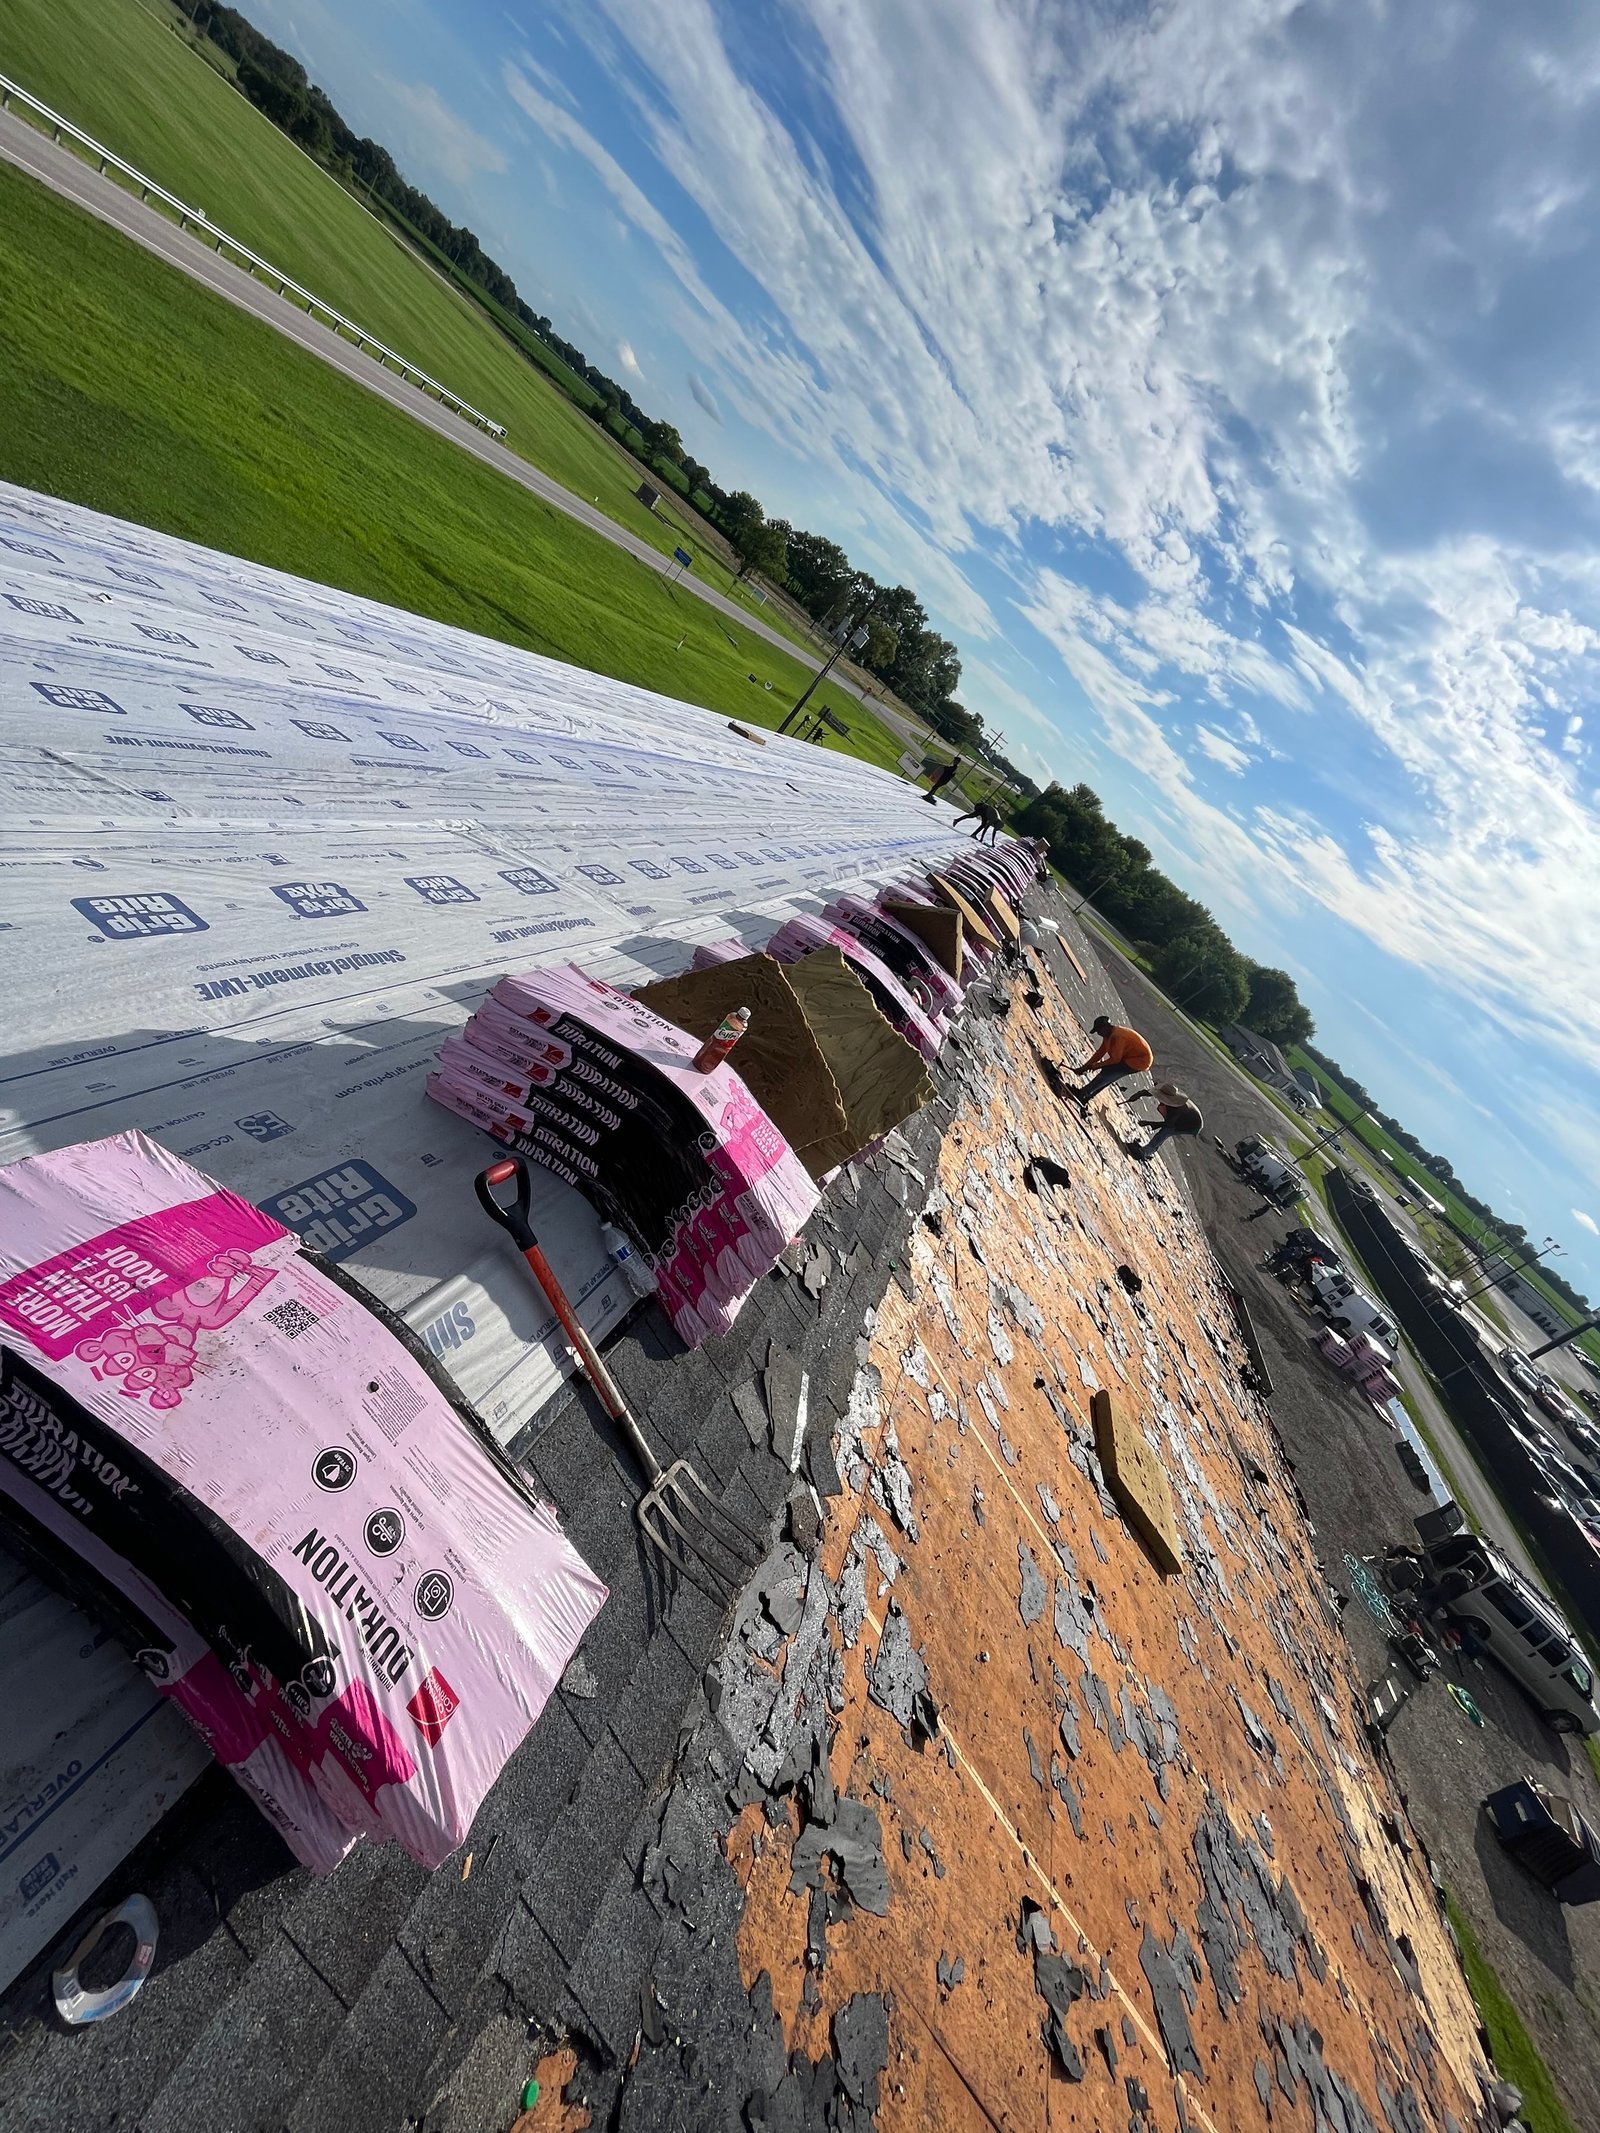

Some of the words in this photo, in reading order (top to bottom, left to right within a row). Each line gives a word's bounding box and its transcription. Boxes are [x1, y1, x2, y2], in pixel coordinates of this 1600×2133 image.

[413, 877, 455, 888] Rite
[504, 869, 540, 881] Rite
[425, 889, 475, 900] Grip
[518, 880, 555, 893] Grip
[89, 895, 177, 914] Rite
[106, 913, 197, 934] Grip
[193, 949, 407, 1002] ShingleLayment-LWE
[612, 995, 674, 1032] DURATION
[72, 1045, 116, 1061] OVERLAP
[283, 1045, 313, 1059] OVERLAP
[554, 1022, 622, 1070] DURATION
[47, 1056, 72, 1066] LINE
[265, 1053, 283, 1064] LINE
[179, 1080, 199, 1090] LINE
[199, 1069, 235, 1084] OVERLAP
[334, 1058, 433, 1100] www.grip-rite.com
[571, 1058, 638, 1111] DURATION
[554, 1080, 621, 1131] DURATION
[529, 1095, 601, 1147] DURATION
[515, 1139, 578, 1186] DURATION
[532, 1127, 599, 1178] DURATION
[276, 1167, 374, 1222] Rite
[742, 1194, 760, 1216] ESTATE
[302, 1193, 403, 1254] Grip
[71, 1257, 98, 1272] A
[95, 1245, 169, 1289] ROOF
[590, 1264, 610, 1286] OVERLAP
[34, 1269, 112, 1321] THAN
[83, 1269, 140, 1302] JUST
[578, 1281, 591, 1296] LINE
[2, 1383, 139, 1500] DURATION
[333, 1452, 347, 1467] YEAR
[291, 1526, 415, 1684] DURATION
